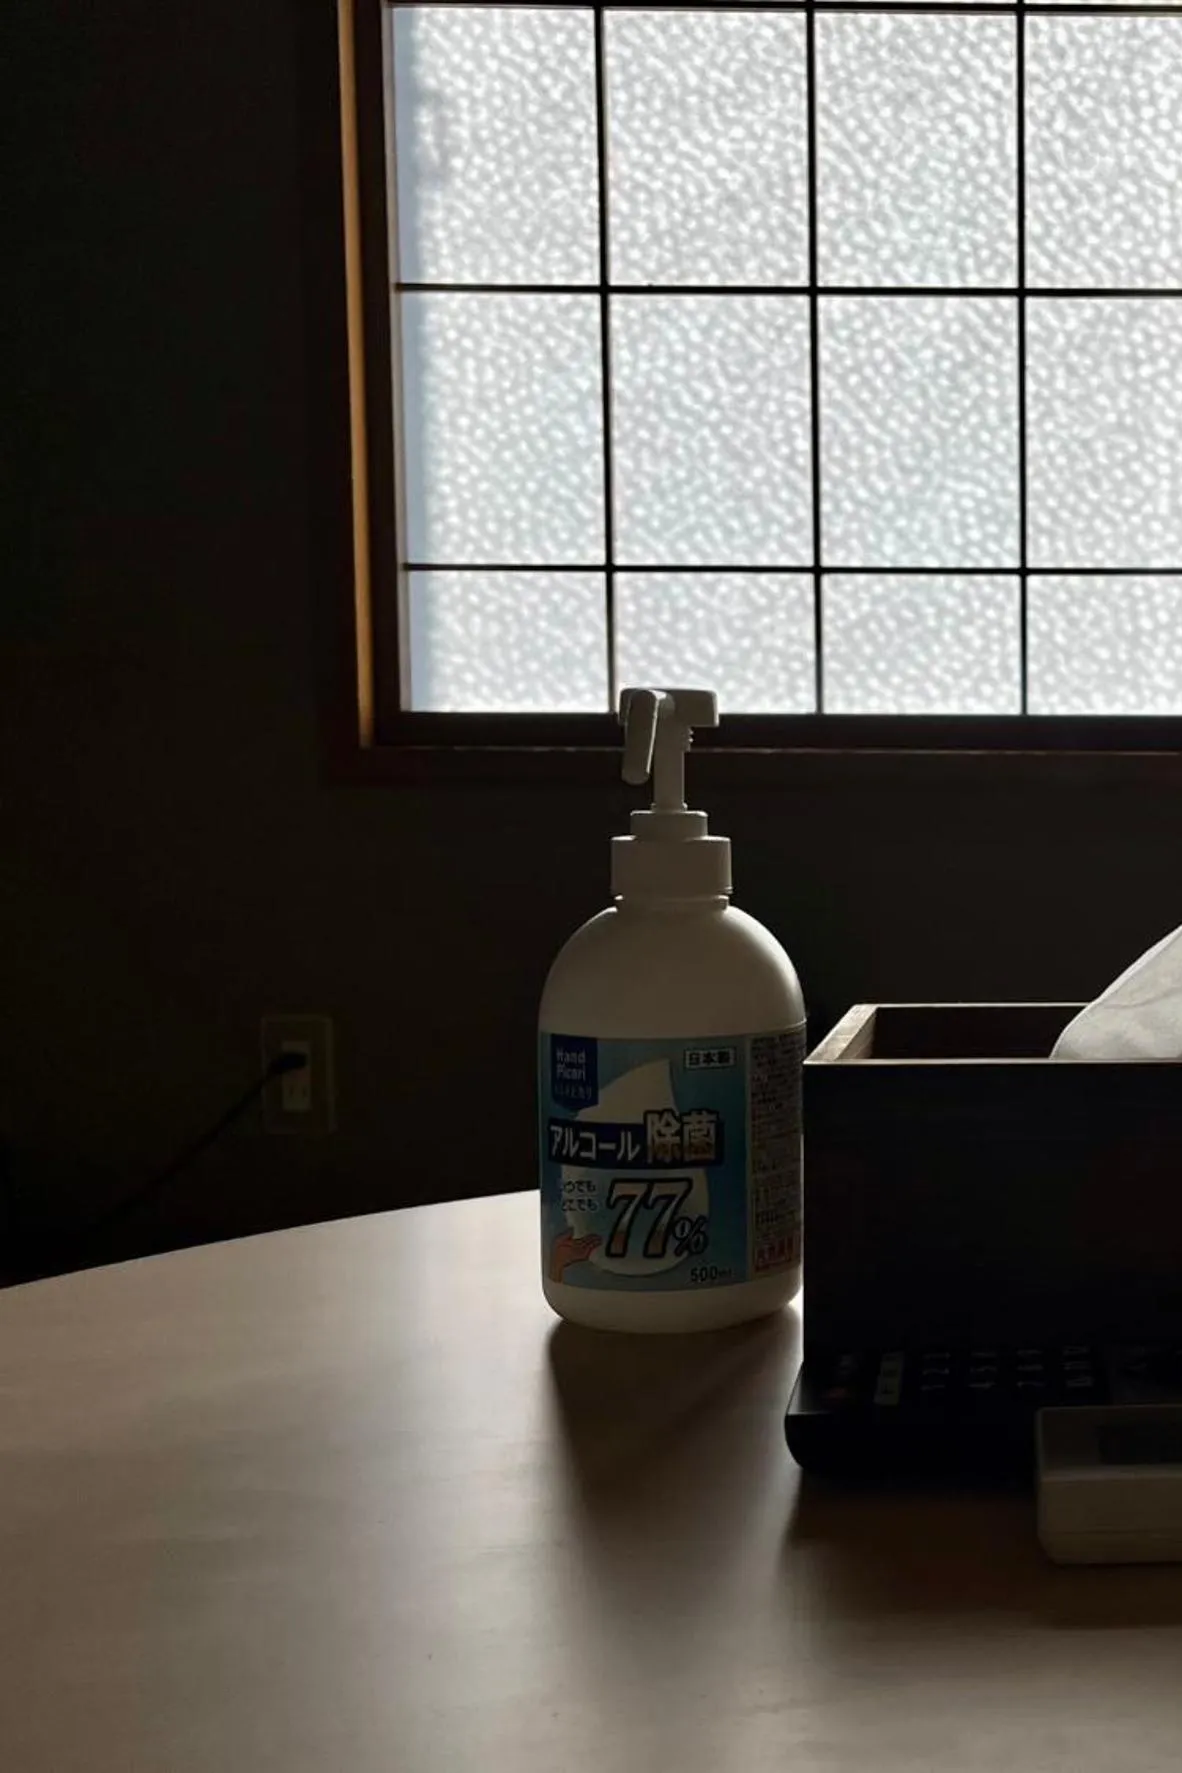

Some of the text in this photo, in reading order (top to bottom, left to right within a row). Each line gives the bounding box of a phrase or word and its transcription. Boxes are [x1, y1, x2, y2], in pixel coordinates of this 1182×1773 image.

[549, 1107, 719, 1163] アルコール除菌
[606, 1177, 709, 1259] 77%
